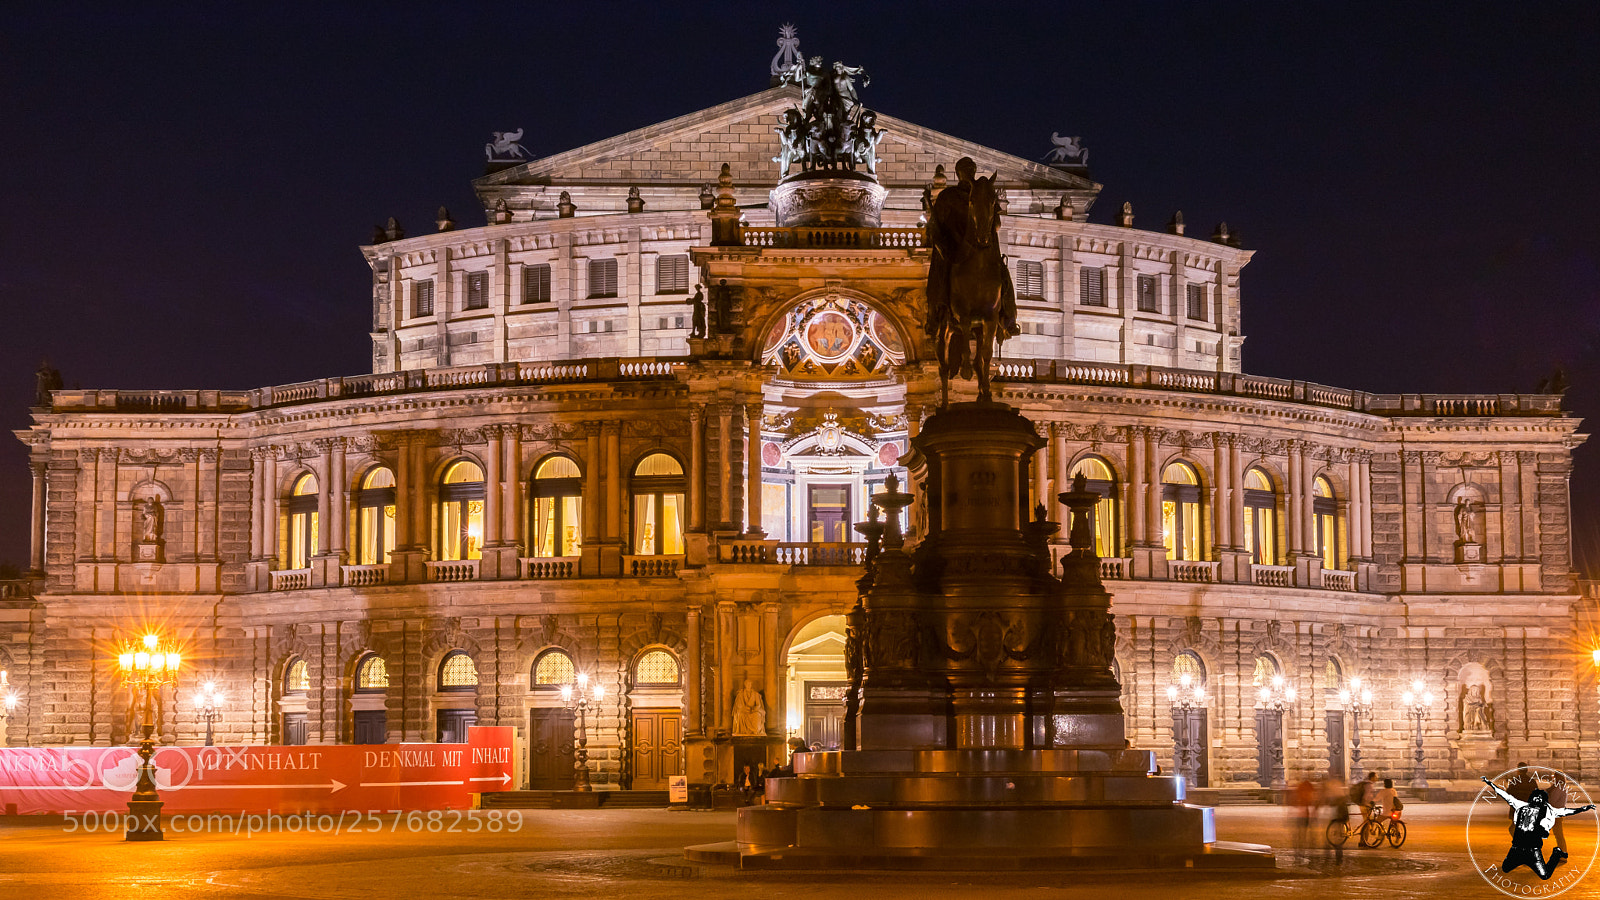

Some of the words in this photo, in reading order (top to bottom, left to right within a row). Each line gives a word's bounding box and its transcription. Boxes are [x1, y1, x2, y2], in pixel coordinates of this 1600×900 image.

[826, 430, 835, 443] A
[195, 754, 232, 771] MIT
[243, 753, 322, 771] INHALT
[364, 750, 436, 768] DENKMAL
[442, 750, 464, 767] MIT
[471, 747, 511, 764] INHALT
